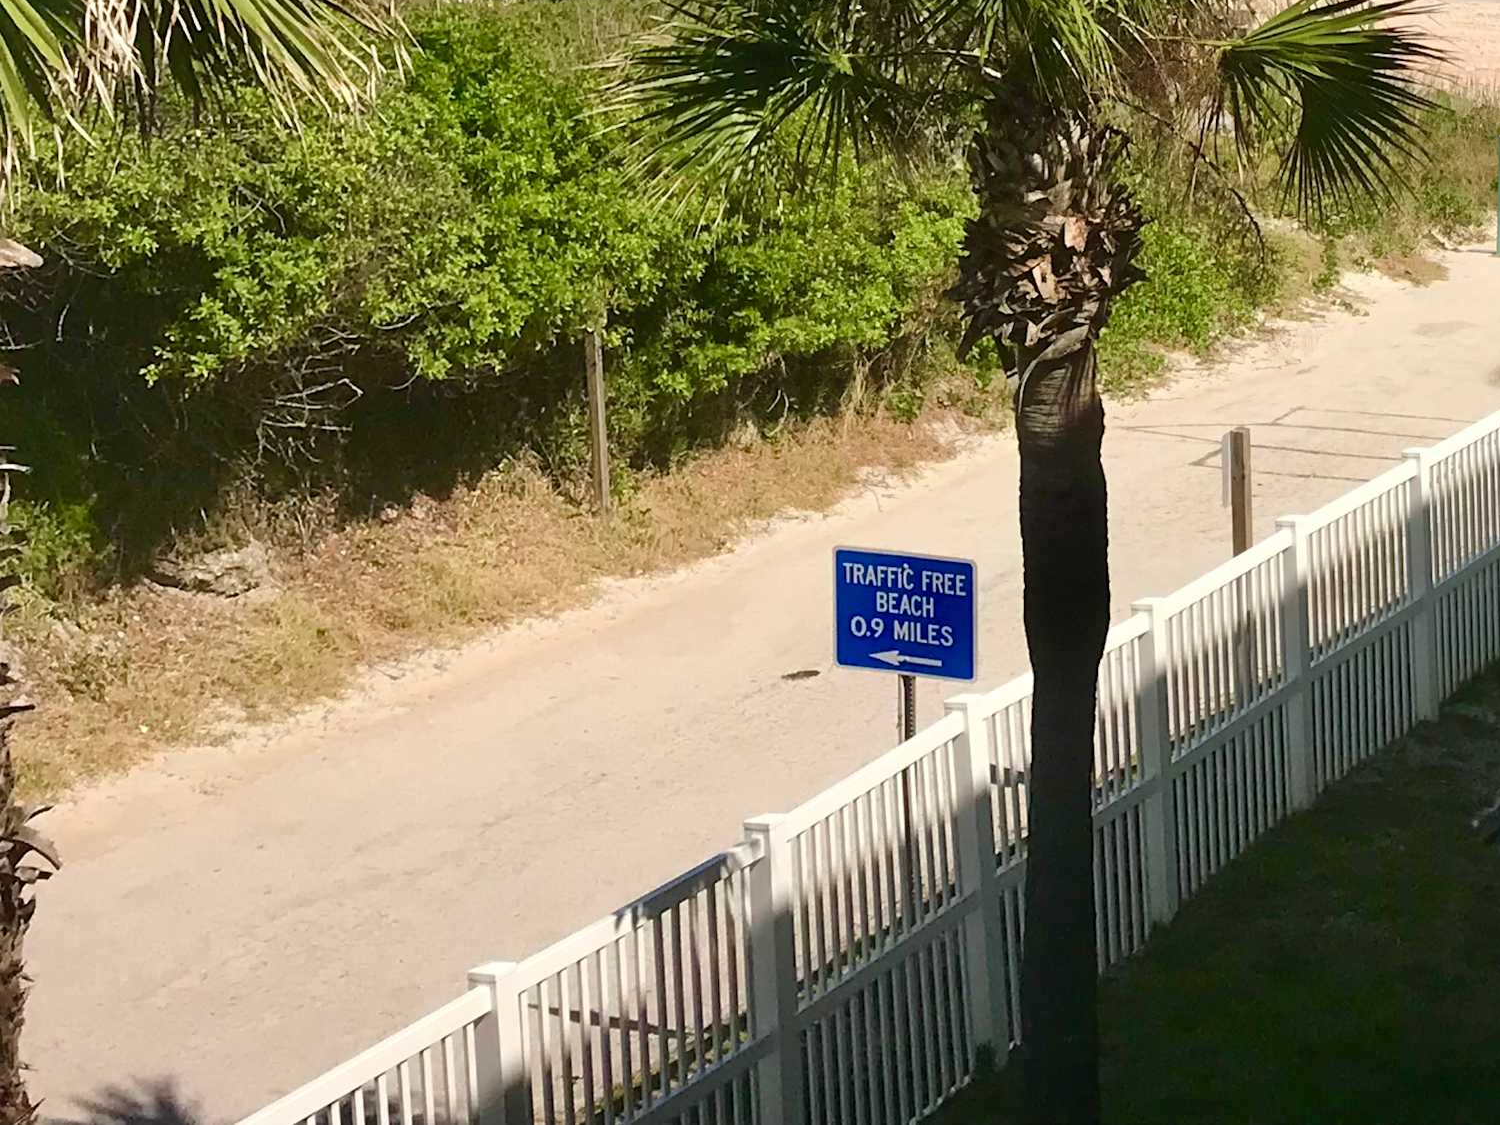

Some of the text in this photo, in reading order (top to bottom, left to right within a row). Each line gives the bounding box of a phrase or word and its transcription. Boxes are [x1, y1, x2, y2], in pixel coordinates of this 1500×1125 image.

[842, 562, 967, 596] TRAFFIC FREE
[876, 591, 934, 618] BEACH
[850, 615, 954, 646] 0.9 MILES
